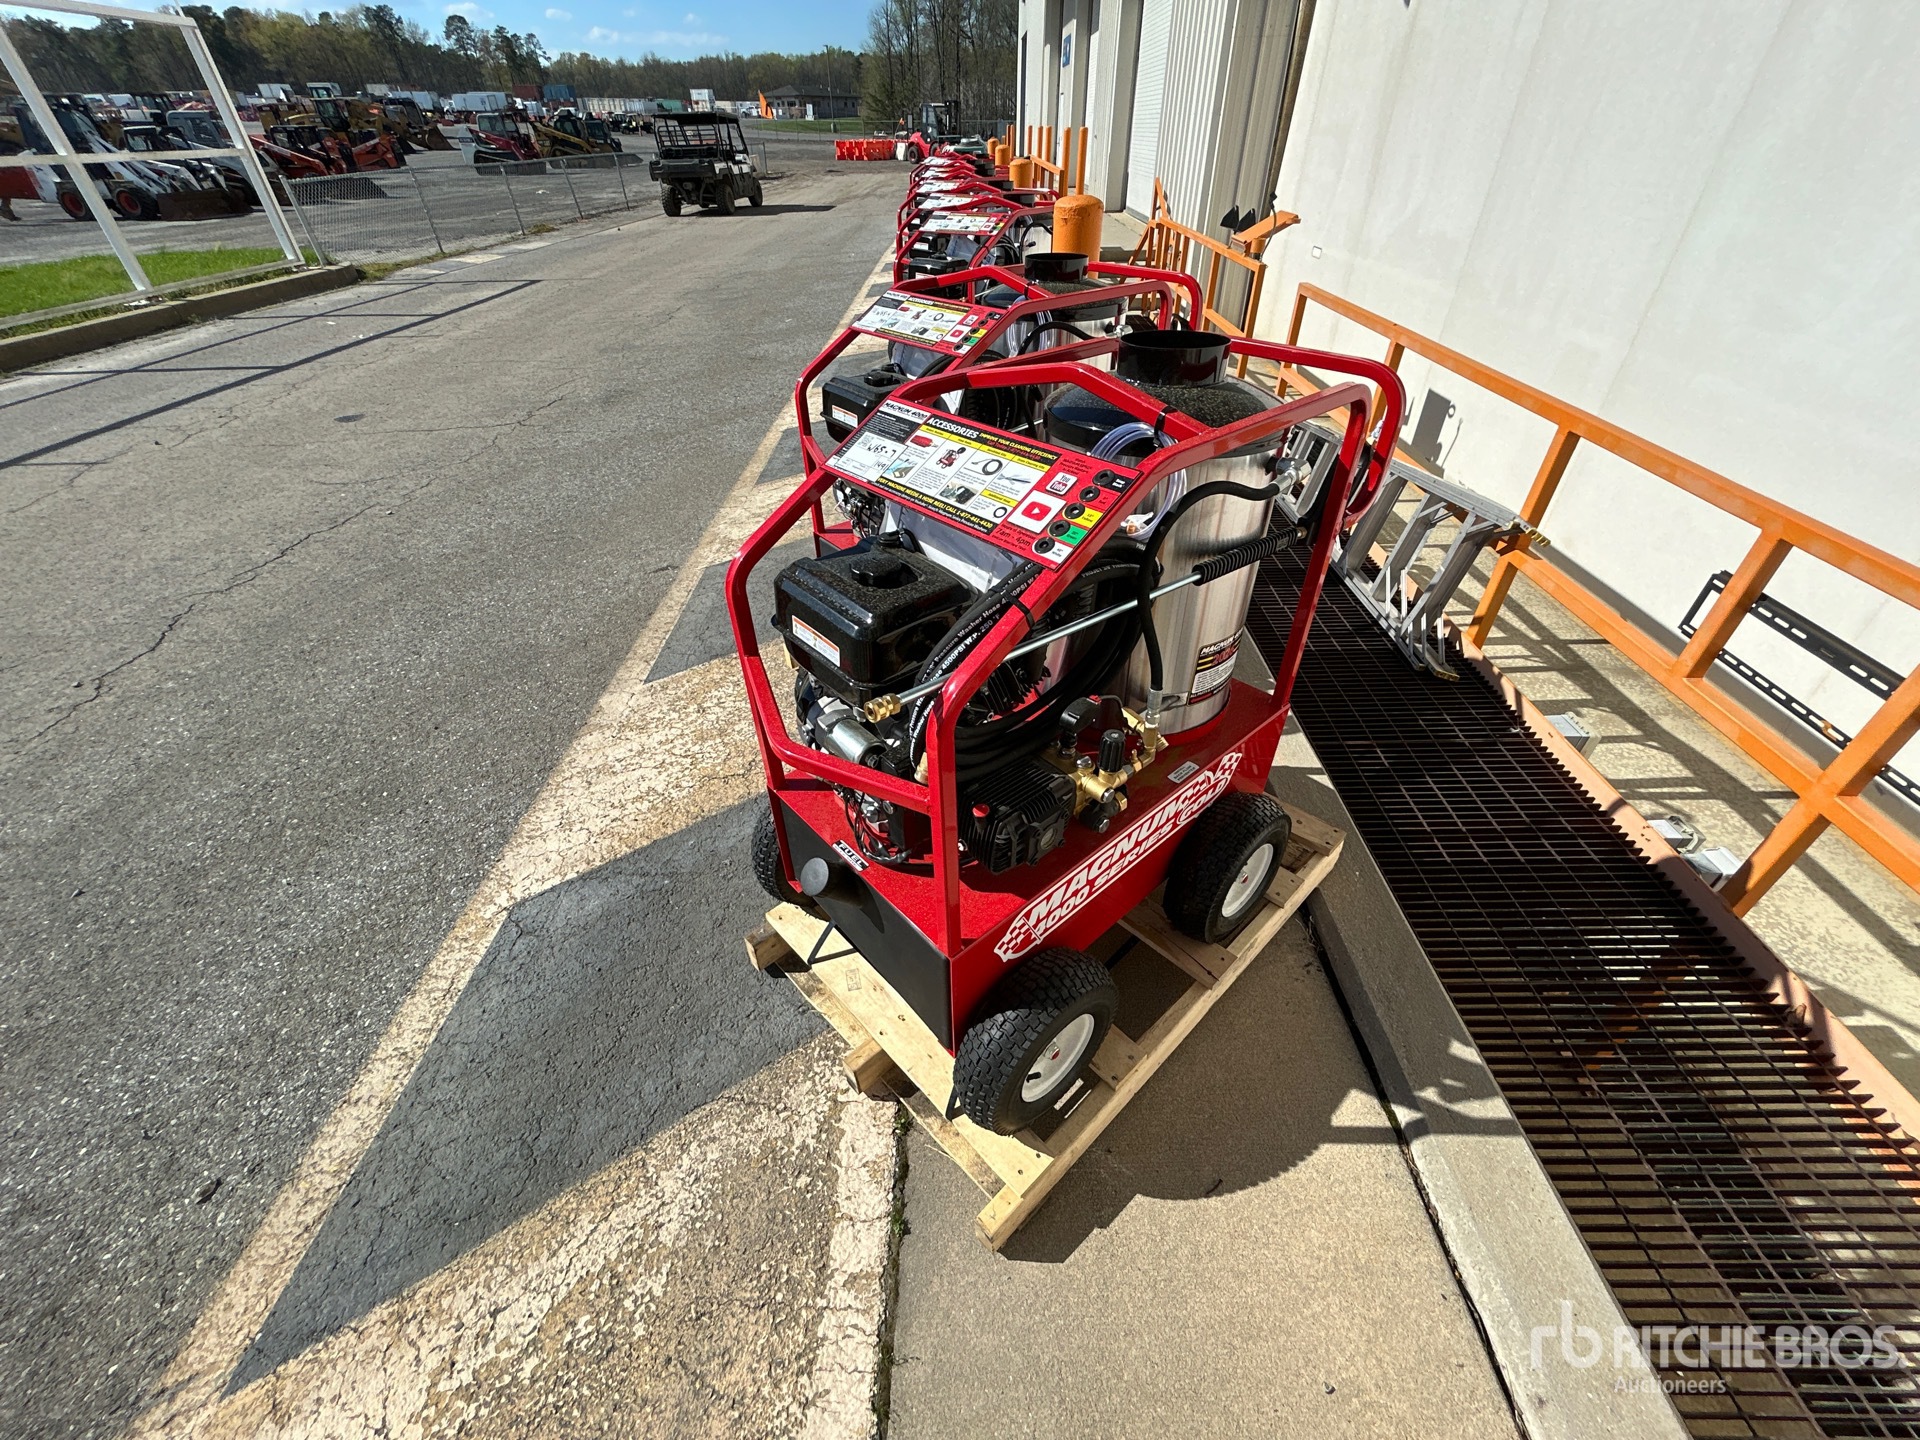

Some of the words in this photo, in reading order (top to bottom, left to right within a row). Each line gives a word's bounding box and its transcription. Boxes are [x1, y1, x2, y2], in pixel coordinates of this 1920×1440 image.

[925, 417, 981, 438] ACCESSORIES
[978, 432, 999, 441] IMPROVE
[1008, 442, 1032, 452] CLEANING
[1029, 448, 1058, 460] EFFICIENCY
[1058, 474, 1073, 483] You
[886, 480, 906, 491] MACHINE
[904, 488, 920, 497] NEEDS
[921, 495, 934, 503] HOSE
[932, 500, 947, 508] REEL!
[944, 505, 958, 513] CALL
[995, 527, 1012, 537] 7am
[1013, 535, 1032, 547] 4pm
[934, 638, 958, 662] Pressure
[958, 616, 982, 638] Washer
[982, 602, 1000, 618] Hose
[942, 644, 966, 670] 4500PSI
[980, 620, 994, 633] 250
[923, 700, 935, 717] Hose
[838, 842, 864, 868] FUEL
[1028, 788, 1195, 927] MAGNUM
[1031, 885, 1090, 940] 4000
[1091, 818, 1176, 892] SERIES
[1180, 779, 1226, 822] GOLD
